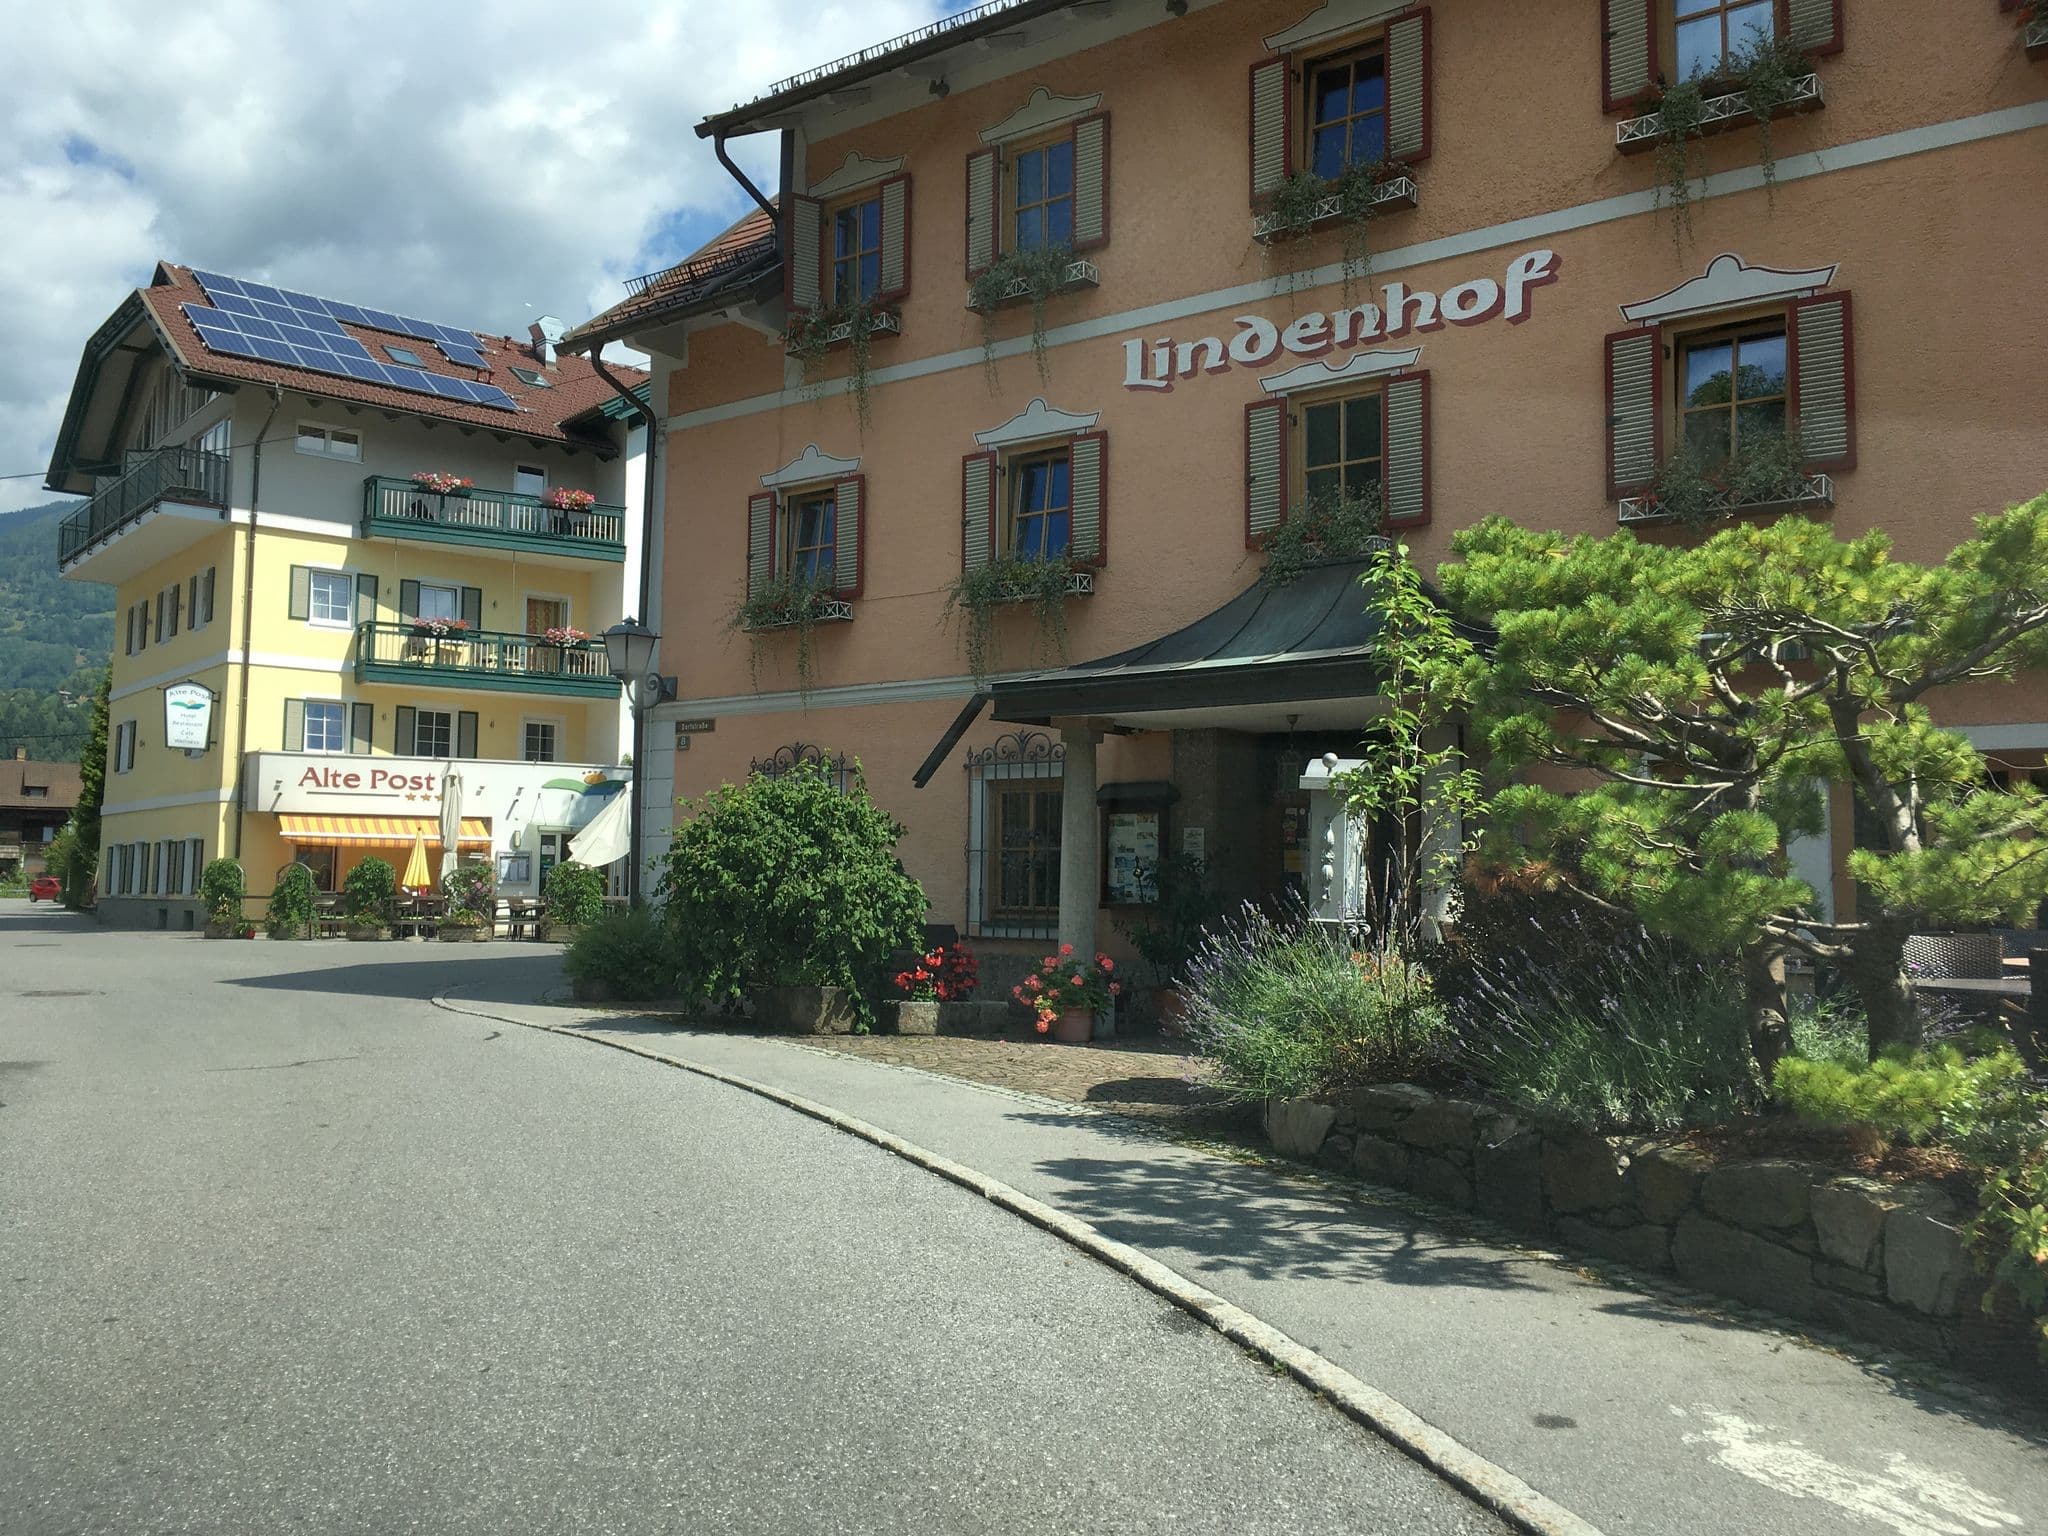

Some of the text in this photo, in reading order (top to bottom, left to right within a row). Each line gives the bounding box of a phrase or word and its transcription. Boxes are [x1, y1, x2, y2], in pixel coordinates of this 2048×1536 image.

[1122, 248, 1560, 392] Lindenhof
[298, 766, 436, 791] Alte Post
